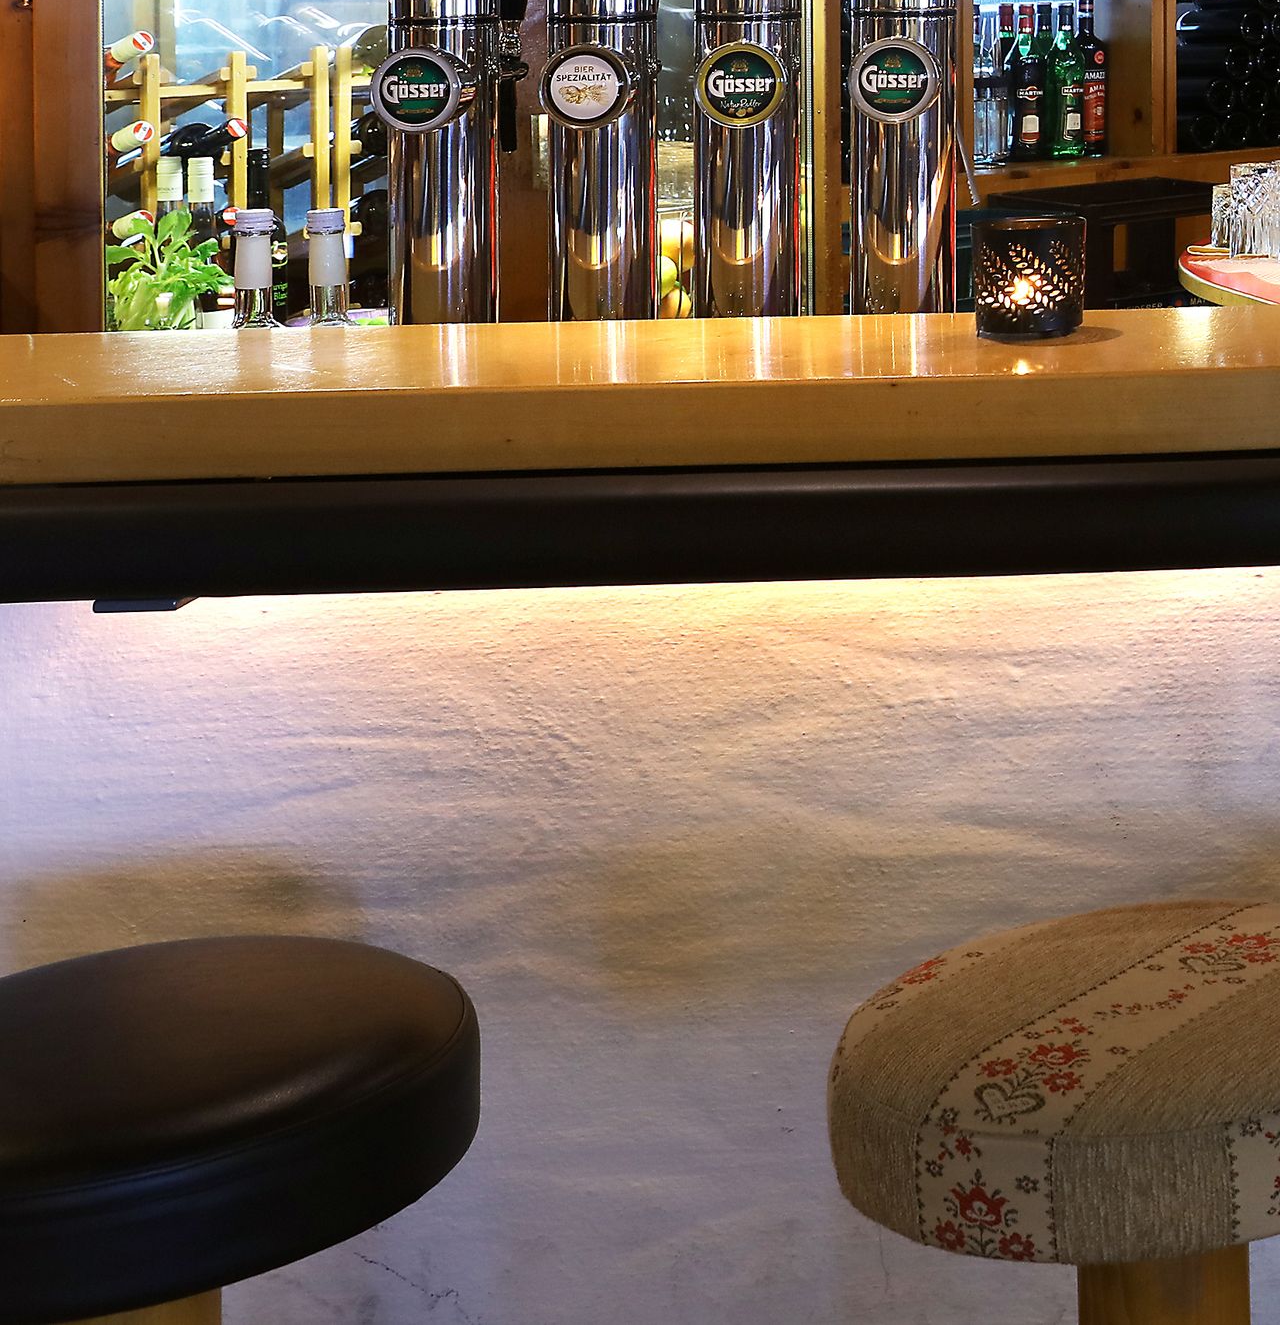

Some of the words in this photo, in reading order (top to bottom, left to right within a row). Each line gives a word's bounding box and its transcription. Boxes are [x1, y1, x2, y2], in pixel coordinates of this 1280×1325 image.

[555, 73, 612, 82] SPEZIALITÄT
[574, 65, 595, 73] BIER
[707, 68, 772, 98] Gösser
[861, 65, 925, 95] Gösser
[381, 75, 447, 104] Gösser
